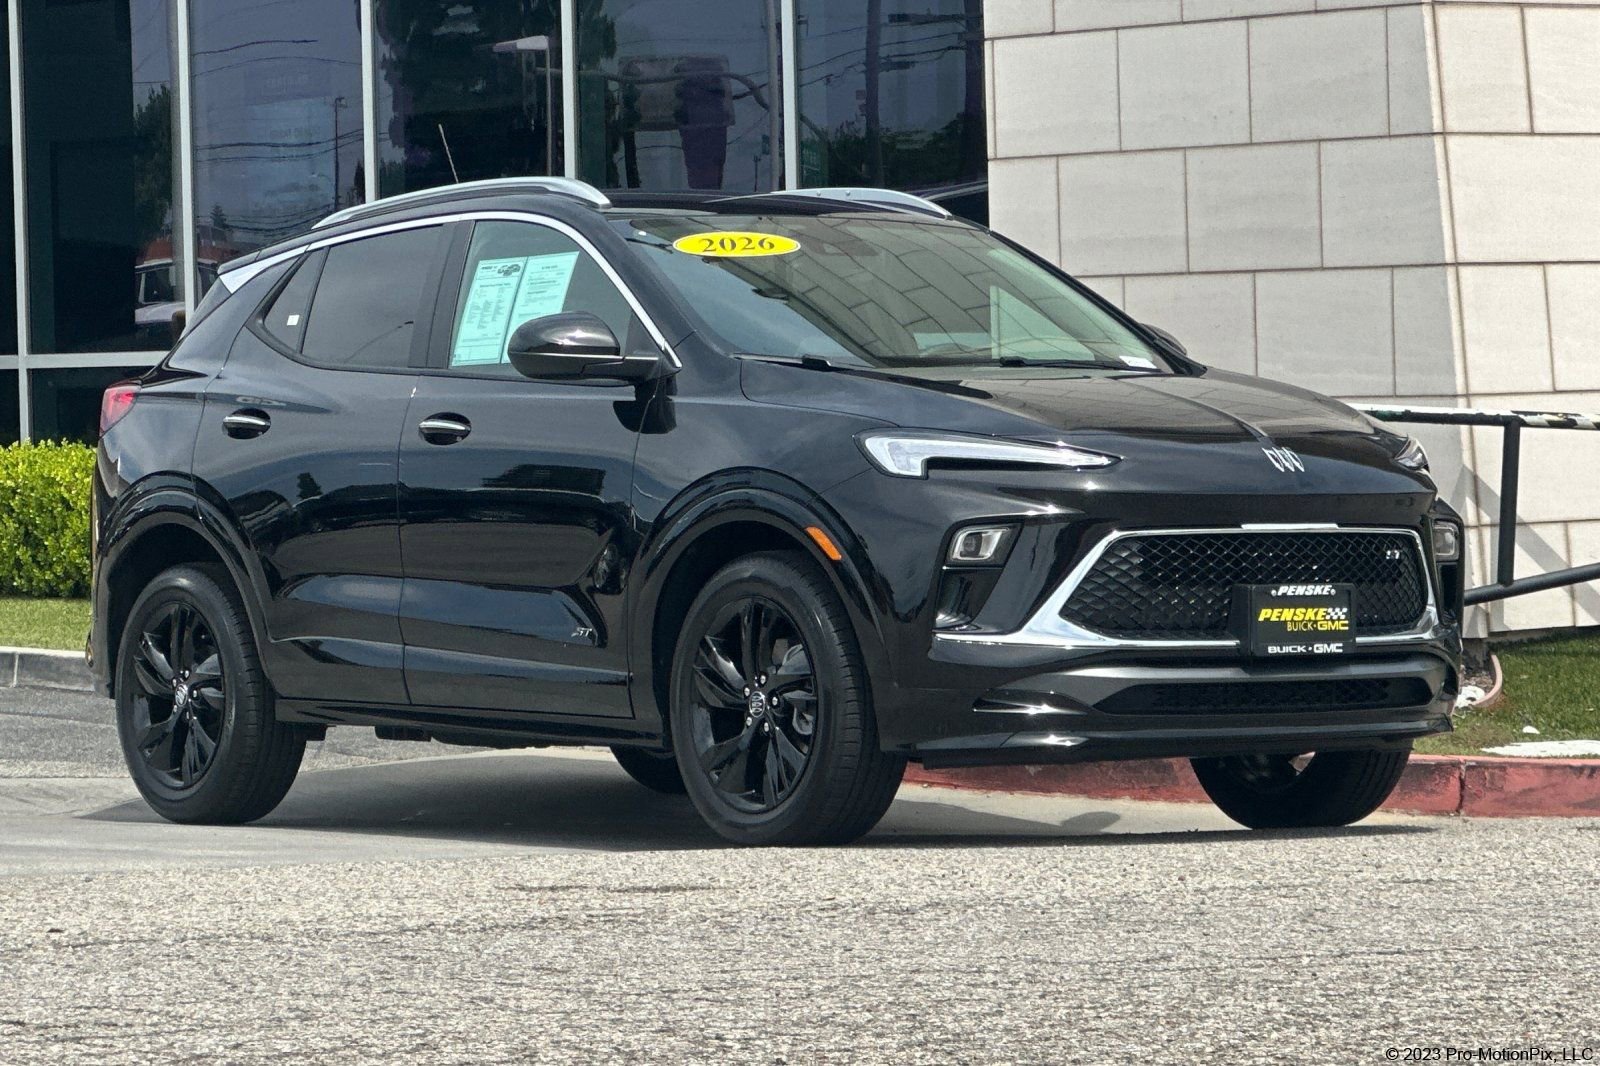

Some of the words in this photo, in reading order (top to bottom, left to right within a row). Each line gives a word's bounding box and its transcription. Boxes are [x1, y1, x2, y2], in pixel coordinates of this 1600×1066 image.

[699, 237, 775, 252] 2026
[1277, 585, 1332, 596] PENSKE
[1258, 608, 1328, 621] PENSKE
[1317, 620, 1349, 630] GMC
[1267, 645, 1307, 653] BUICK
[1313, 643, 1343, 653] GMC
